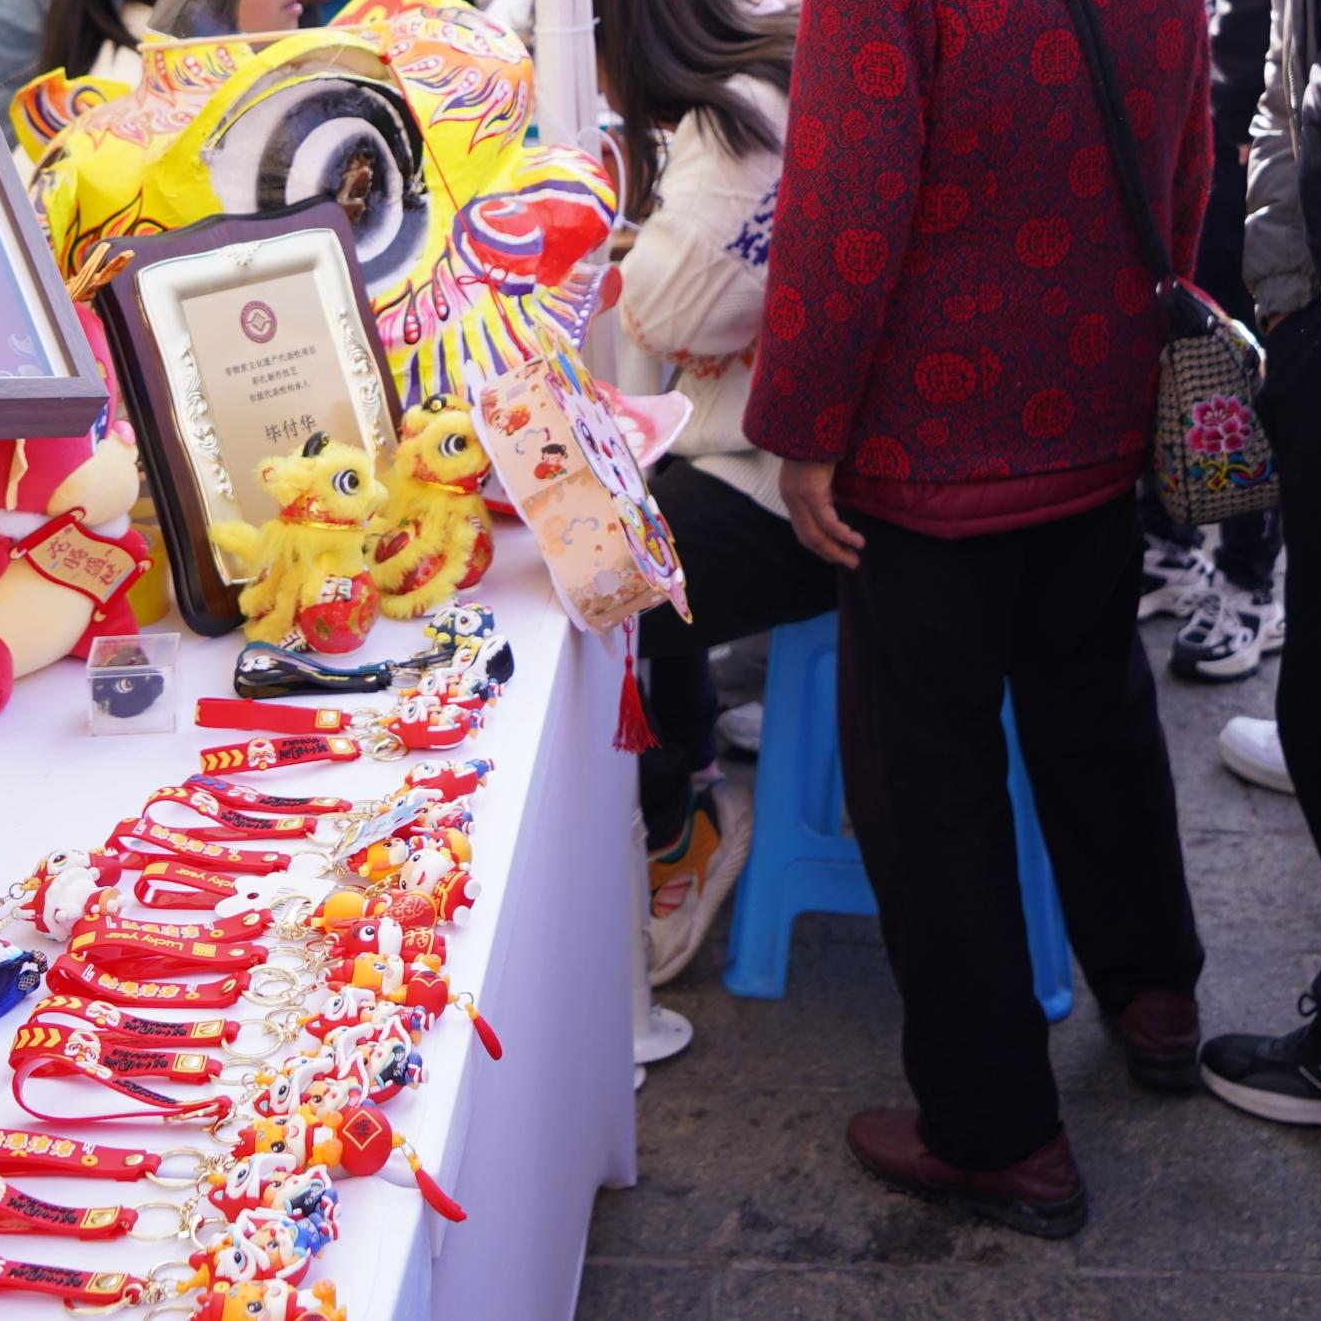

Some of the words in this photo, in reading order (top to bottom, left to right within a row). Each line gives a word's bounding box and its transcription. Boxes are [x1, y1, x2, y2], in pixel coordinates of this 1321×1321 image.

[264, 413, 317, 443] 毕付华
[175, 868, 206, 880] year
[105, 931, 139, 940] year
[141, 934, 184, 951] Lucky
